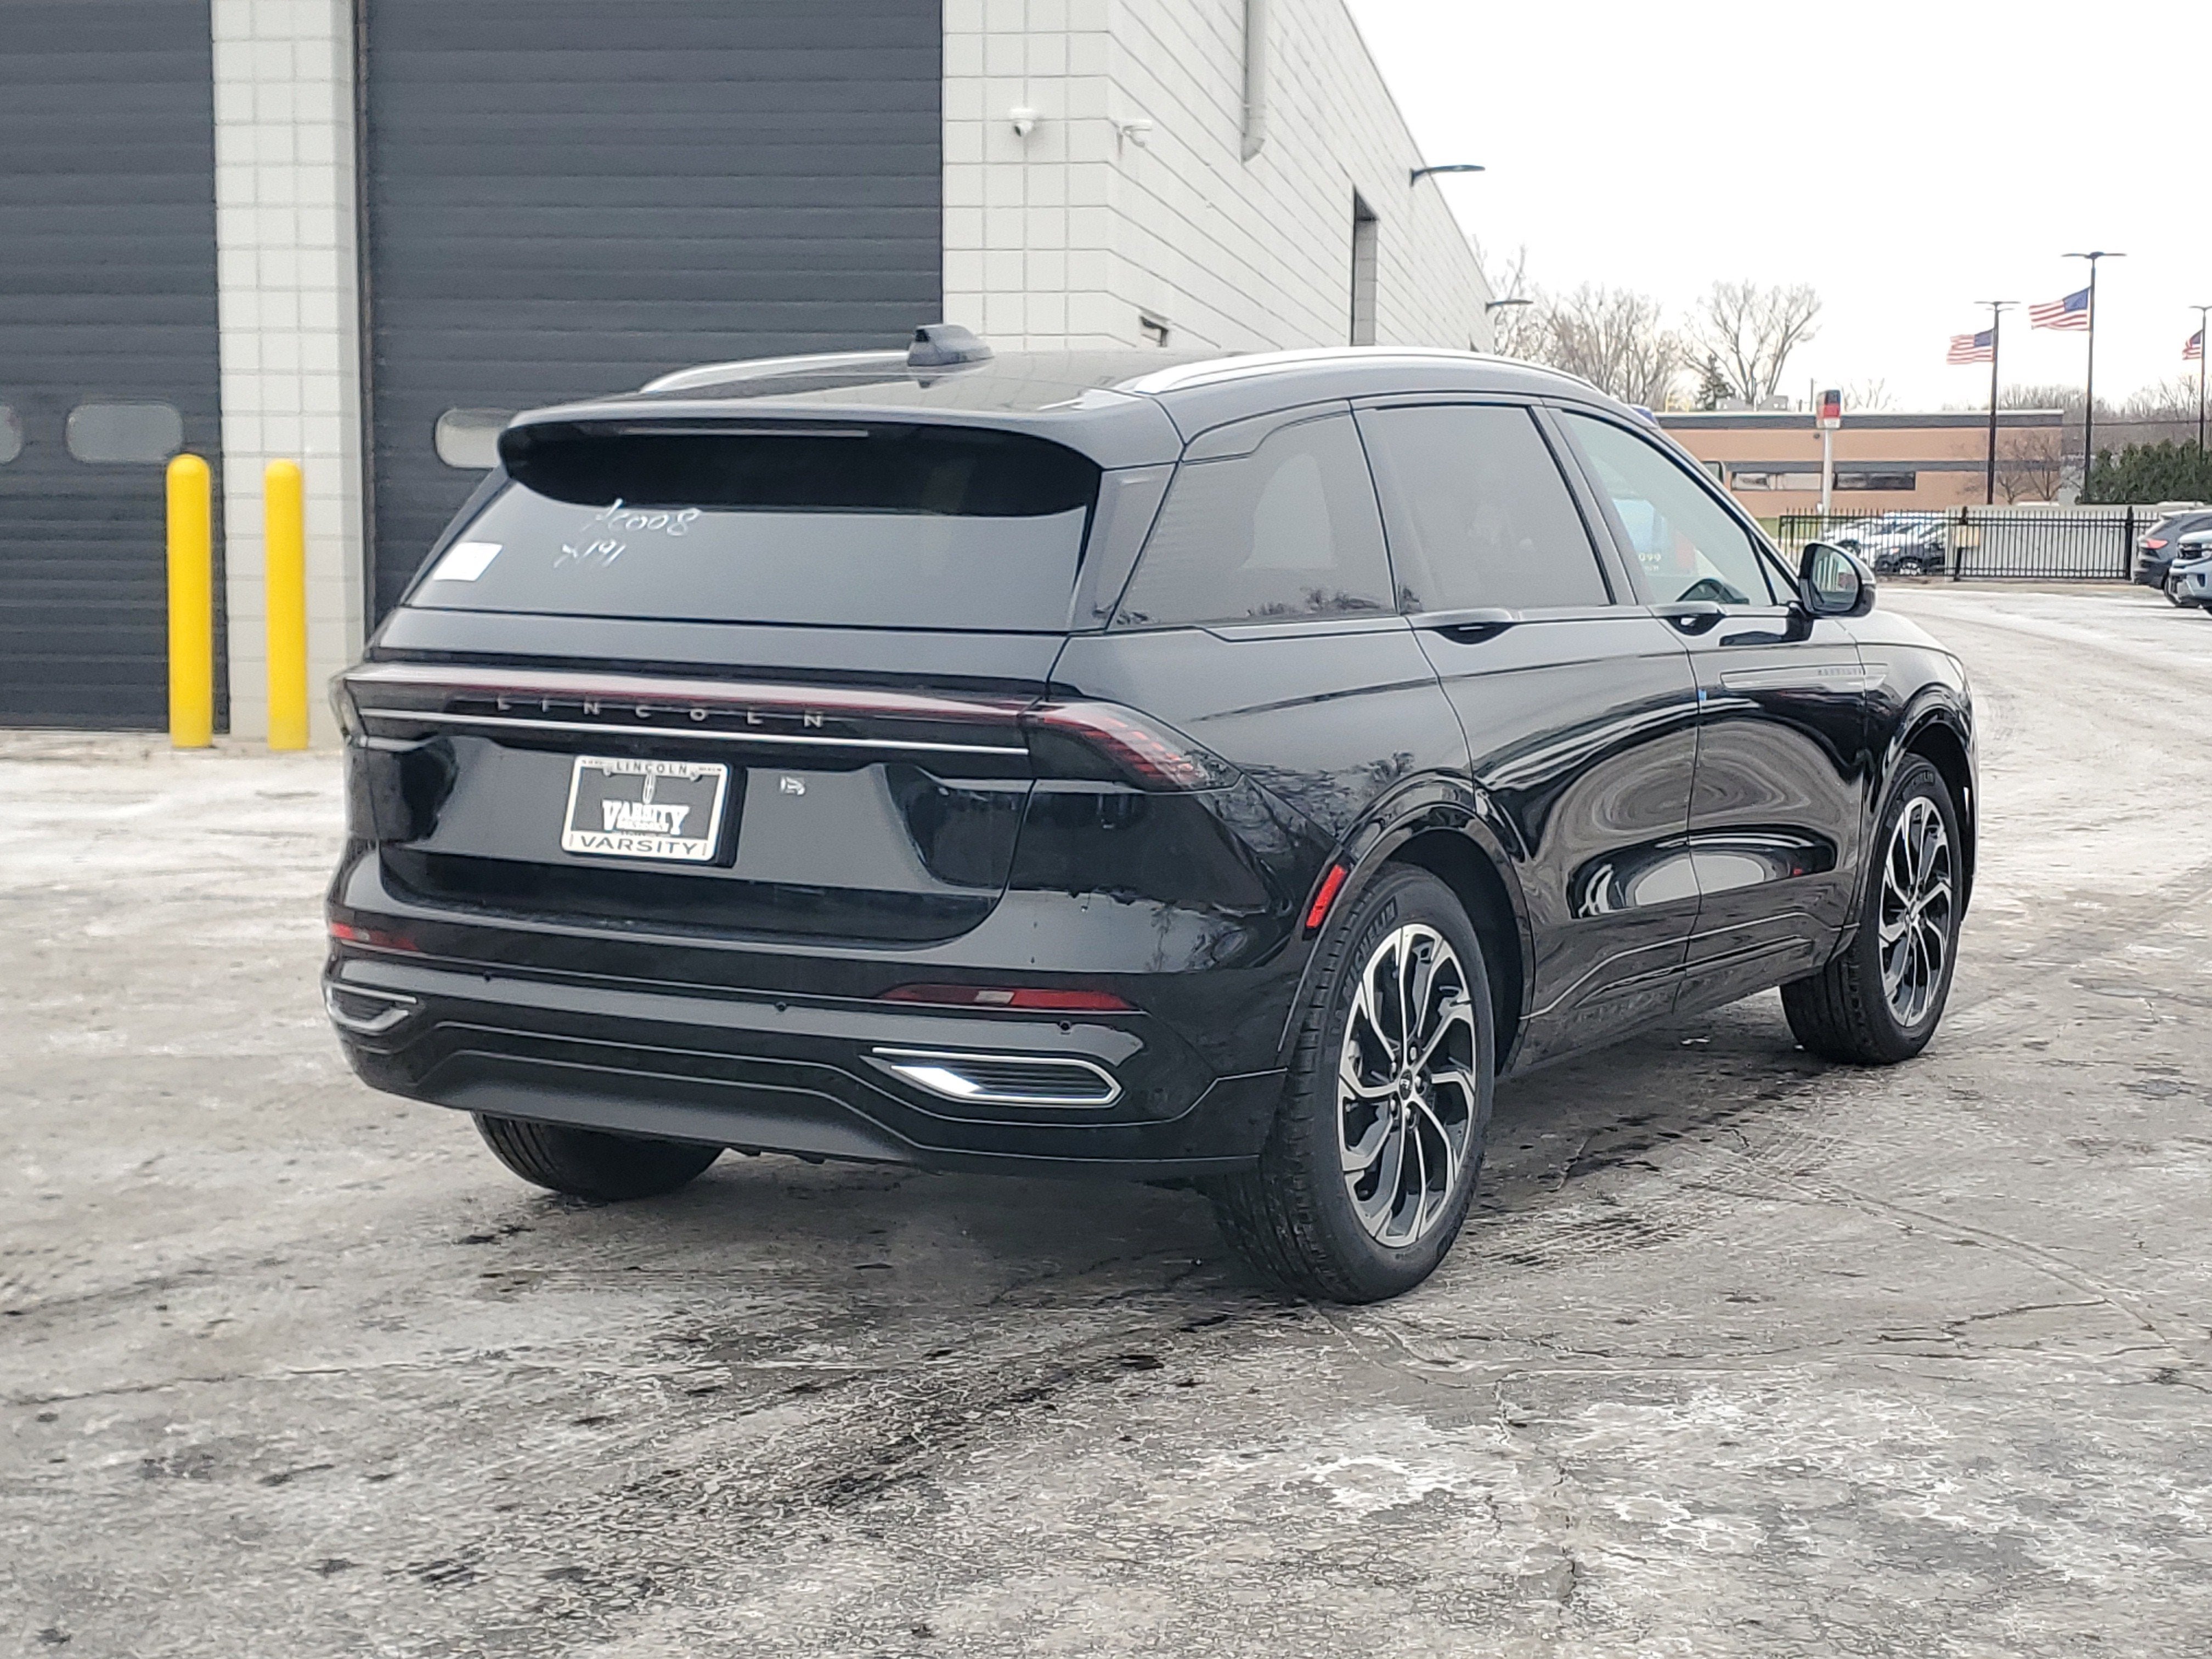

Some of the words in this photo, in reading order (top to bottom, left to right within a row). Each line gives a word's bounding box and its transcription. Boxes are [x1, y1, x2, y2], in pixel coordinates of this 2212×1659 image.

[496, 696, 823, 728] LINCOLN
[616, 761, 687, 775] LINCOLN
[602, 799, 690, 836] VARSITY
[580, 836, 698, 855] VARSITY
